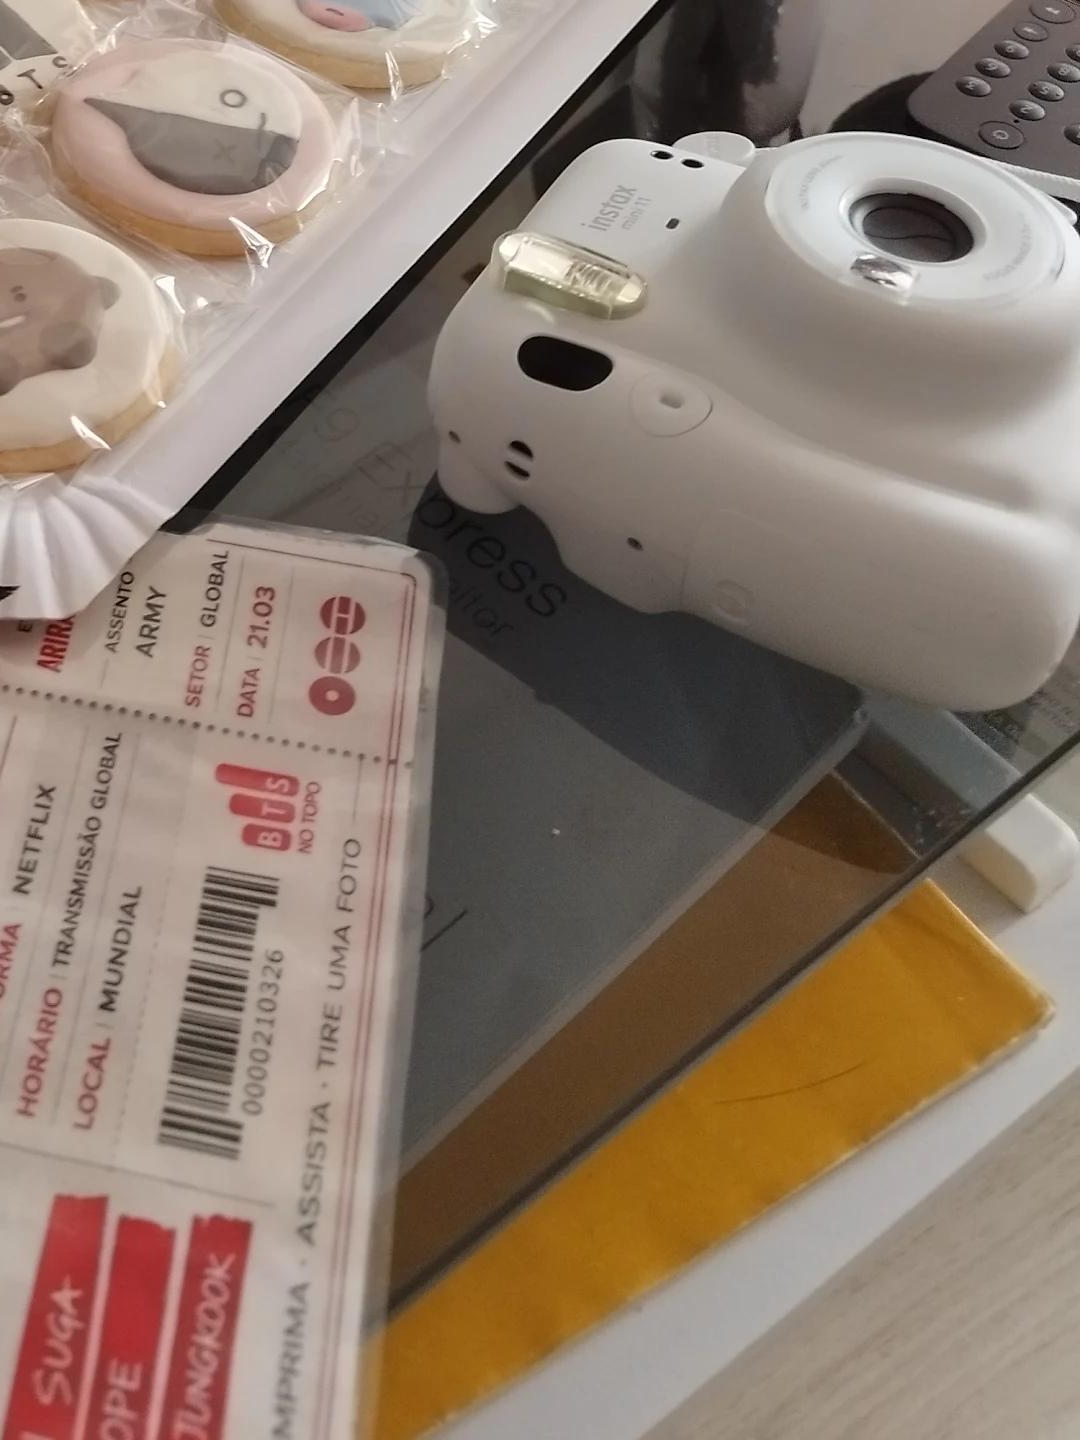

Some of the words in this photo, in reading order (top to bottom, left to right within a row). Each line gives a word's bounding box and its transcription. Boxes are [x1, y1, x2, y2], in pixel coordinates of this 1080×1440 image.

[580, 184, 638, 232] instax
[105, 570, 135, 654] ASSENTO
[135, 586, 168, 659] ARMY
[184, 645, 212, 709] SETOR
[200, 550, 229, 629] GLOBAL
[245, 585, 277, 651] 21.03
[236, 666, 261, 719] DATA
[12, 783, 59, 896] NETFLIX
[301, 779, 322, 826] TOPO
[297, 828, 315, 856] NO
[336, 837, 362, 913] FOTO
[15, 986, 65, 1119] HORÁRIO
[52, 814, 104, 969] TRANSMISSÃO
[91, 730, 124, 811] GLOBAL
[324, 922, 353, 991] UMA
[72, 1037, 113, 1131] LOCAL
[99, 884, 144, 1013] MUNDIAL
[241, 948, 286, 1117] 0000210326
[315, 1002, 344, 1071] TIRE
[296, 1101, 332, 1247] ASSISTA
[32, 1275, 86, 1406] SUGA
